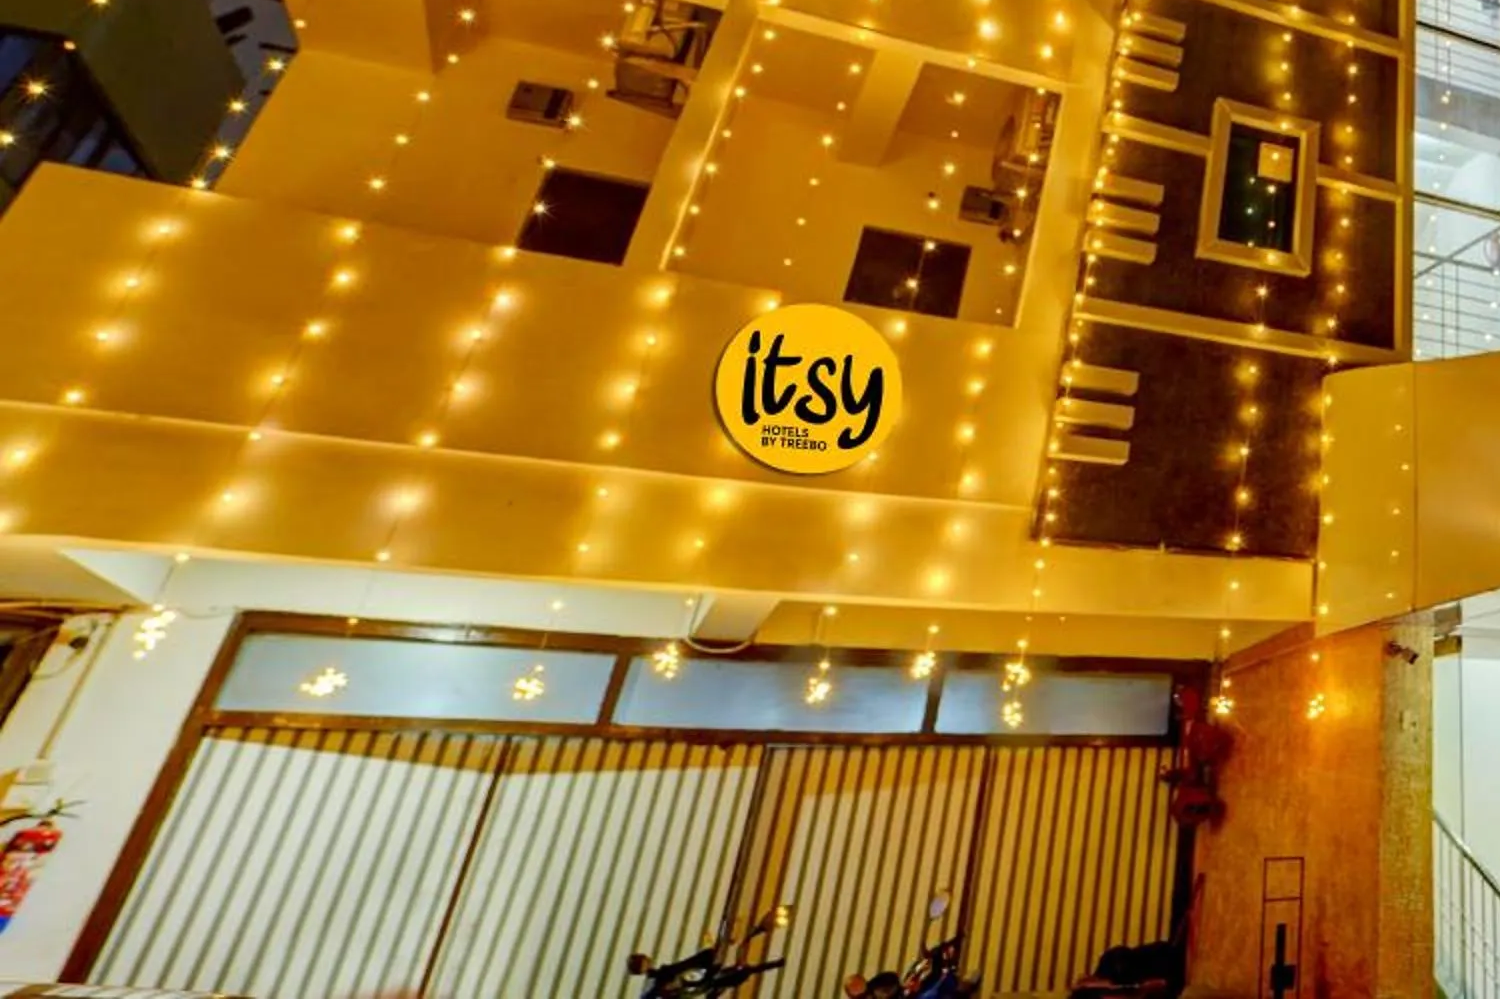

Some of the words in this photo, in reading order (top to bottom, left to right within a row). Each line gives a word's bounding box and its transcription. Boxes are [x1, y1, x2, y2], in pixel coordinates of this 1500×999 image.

[742, 330, 883, 449] itsy
[762, 425, 809, 438] HOTELS
[761, 436, 777, 447] BY
[780, 437, 828, 452] TREEBO
